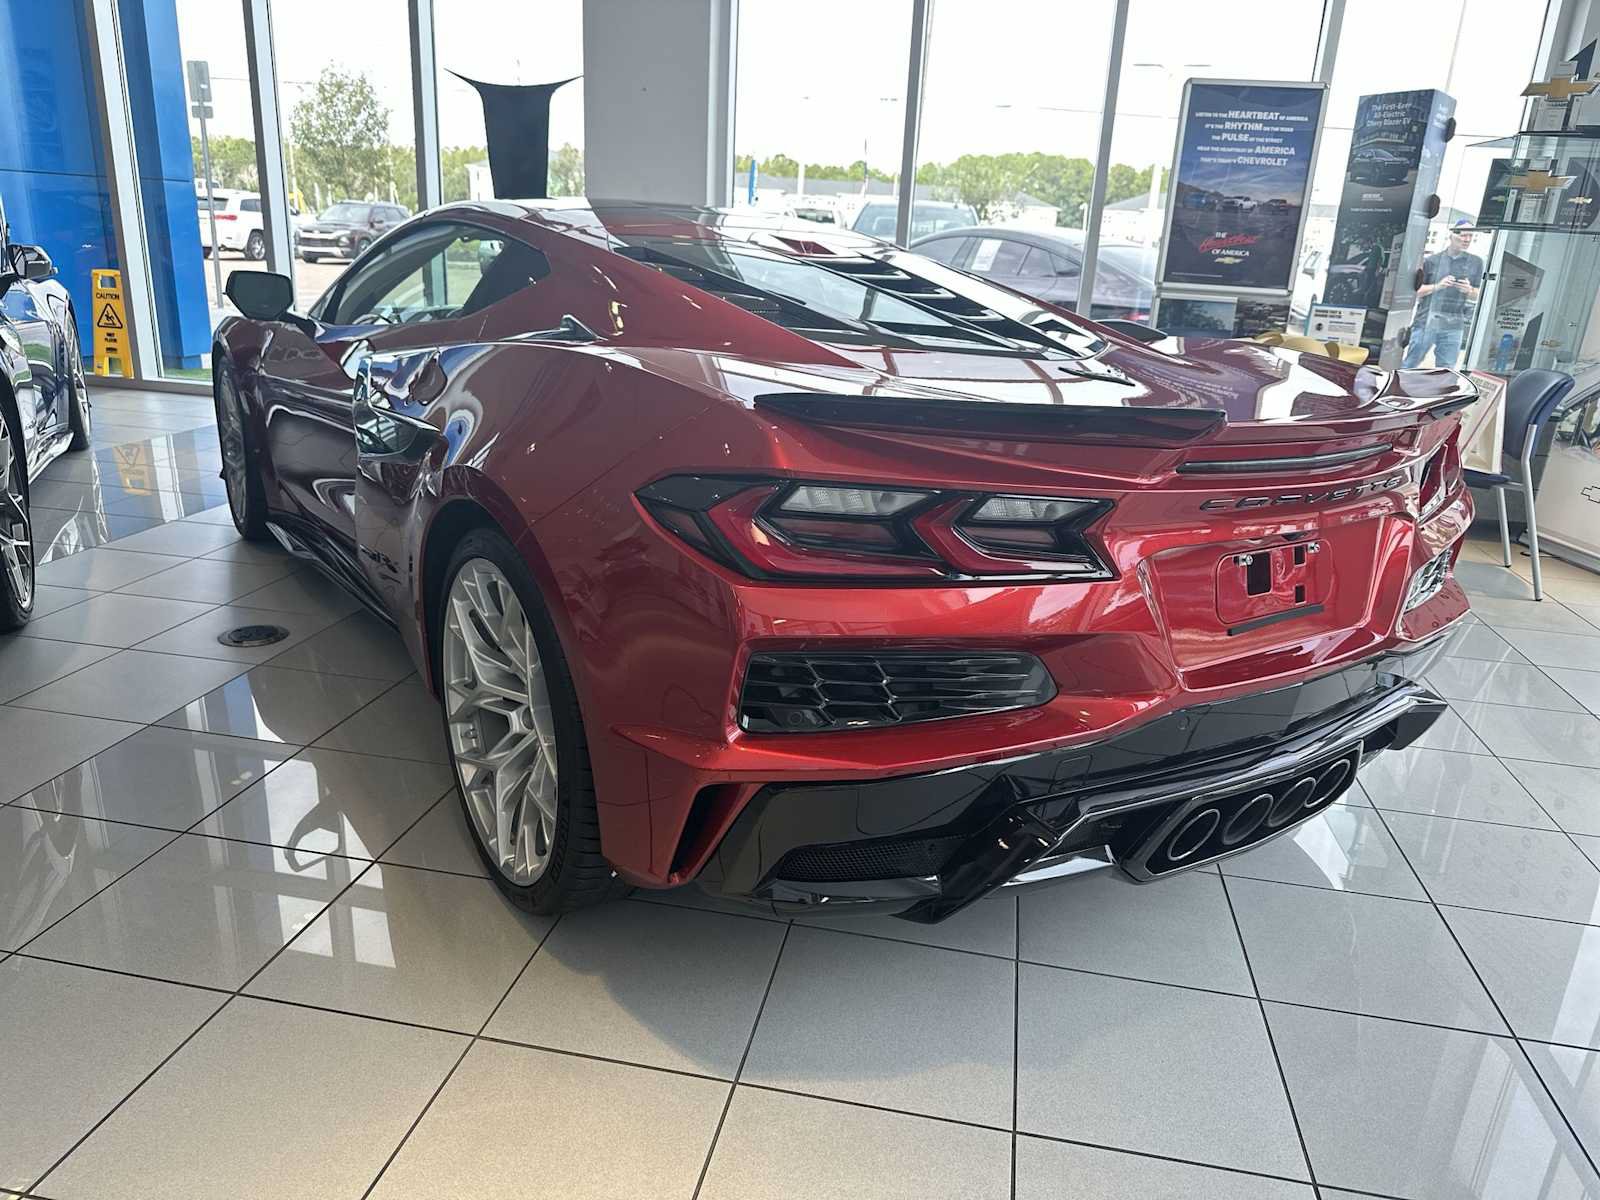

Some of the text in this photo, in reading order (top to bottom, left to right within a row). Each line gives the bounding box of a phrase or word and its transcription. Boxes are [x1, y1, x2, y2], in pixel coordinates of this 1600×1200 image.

[1228, 110, 1280, 120] HEARTBEAT
[1224, 121, 1263, 131] RHYTHM
[1222, 132, 1249, 142] PULSE
[1254, 146, 1295, 155] AMERICA
[1237, 156, 1288, 166] CHEVROLET
[96, 292, 119, 300] CAUTION
[1200, 476, 1402, 510] CORVETTE
